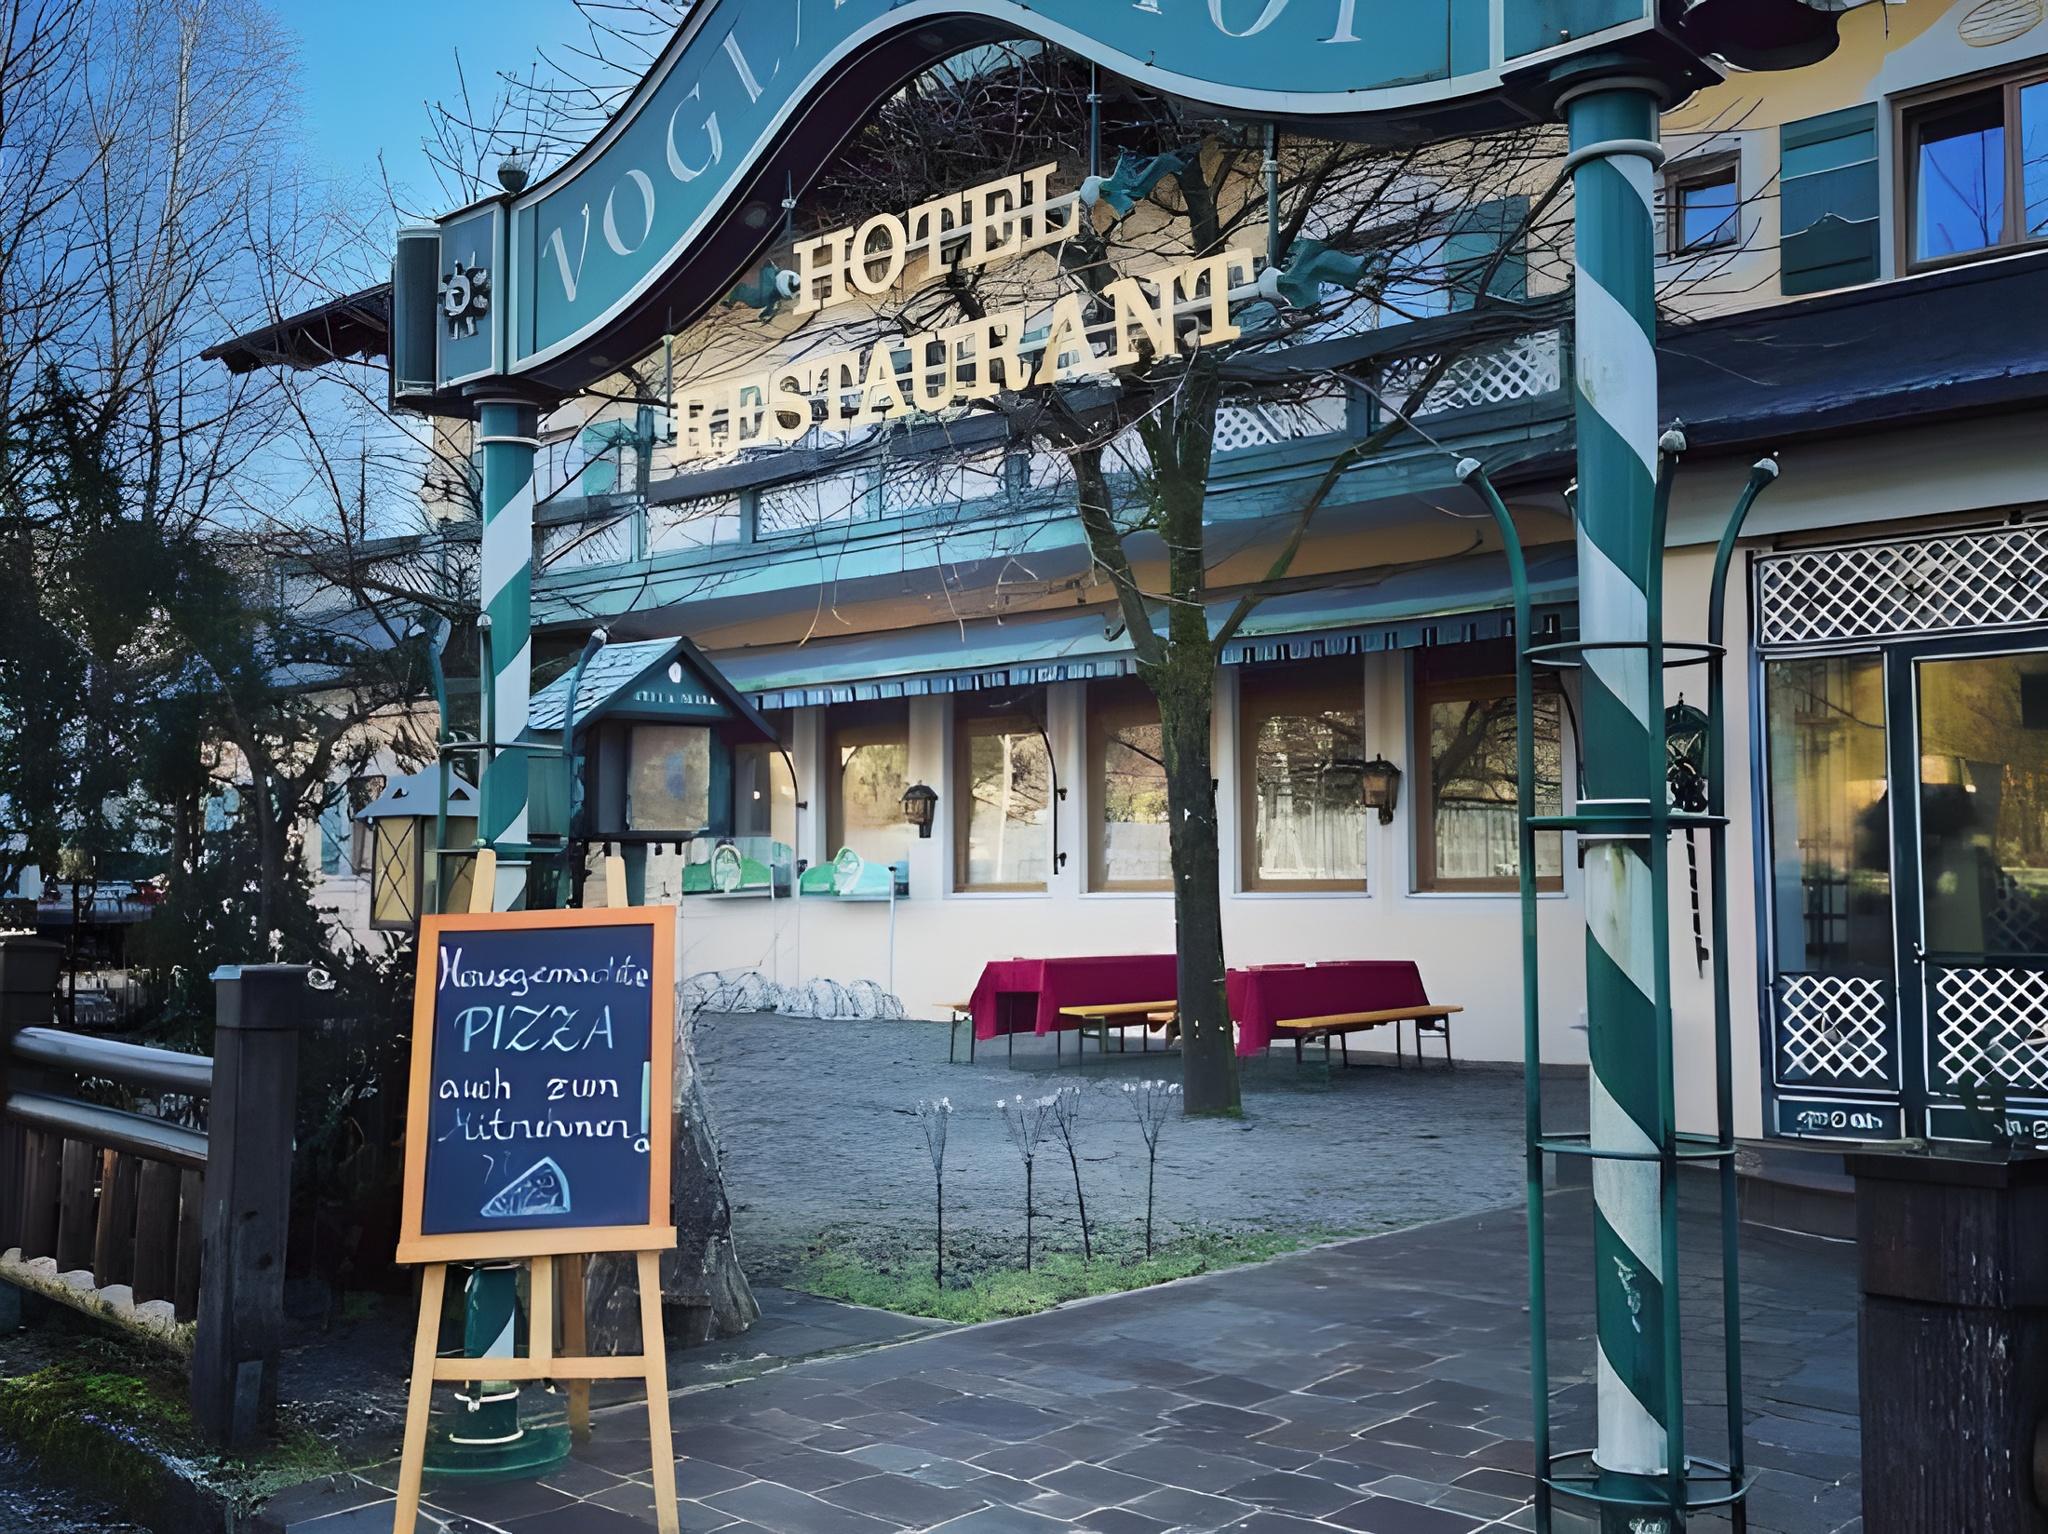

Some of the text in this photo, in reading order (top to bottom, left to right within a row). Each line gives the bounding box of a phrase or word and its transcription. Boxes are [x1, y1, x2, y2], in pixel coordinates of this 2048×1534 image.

[793, 161, 1081, 316] HOTEL
[674, 247, 1256, 463] RESTAURANT
[454, 1004, 614, 1052] PIZZA
[439, 1068, 619, 1101] auch zum
